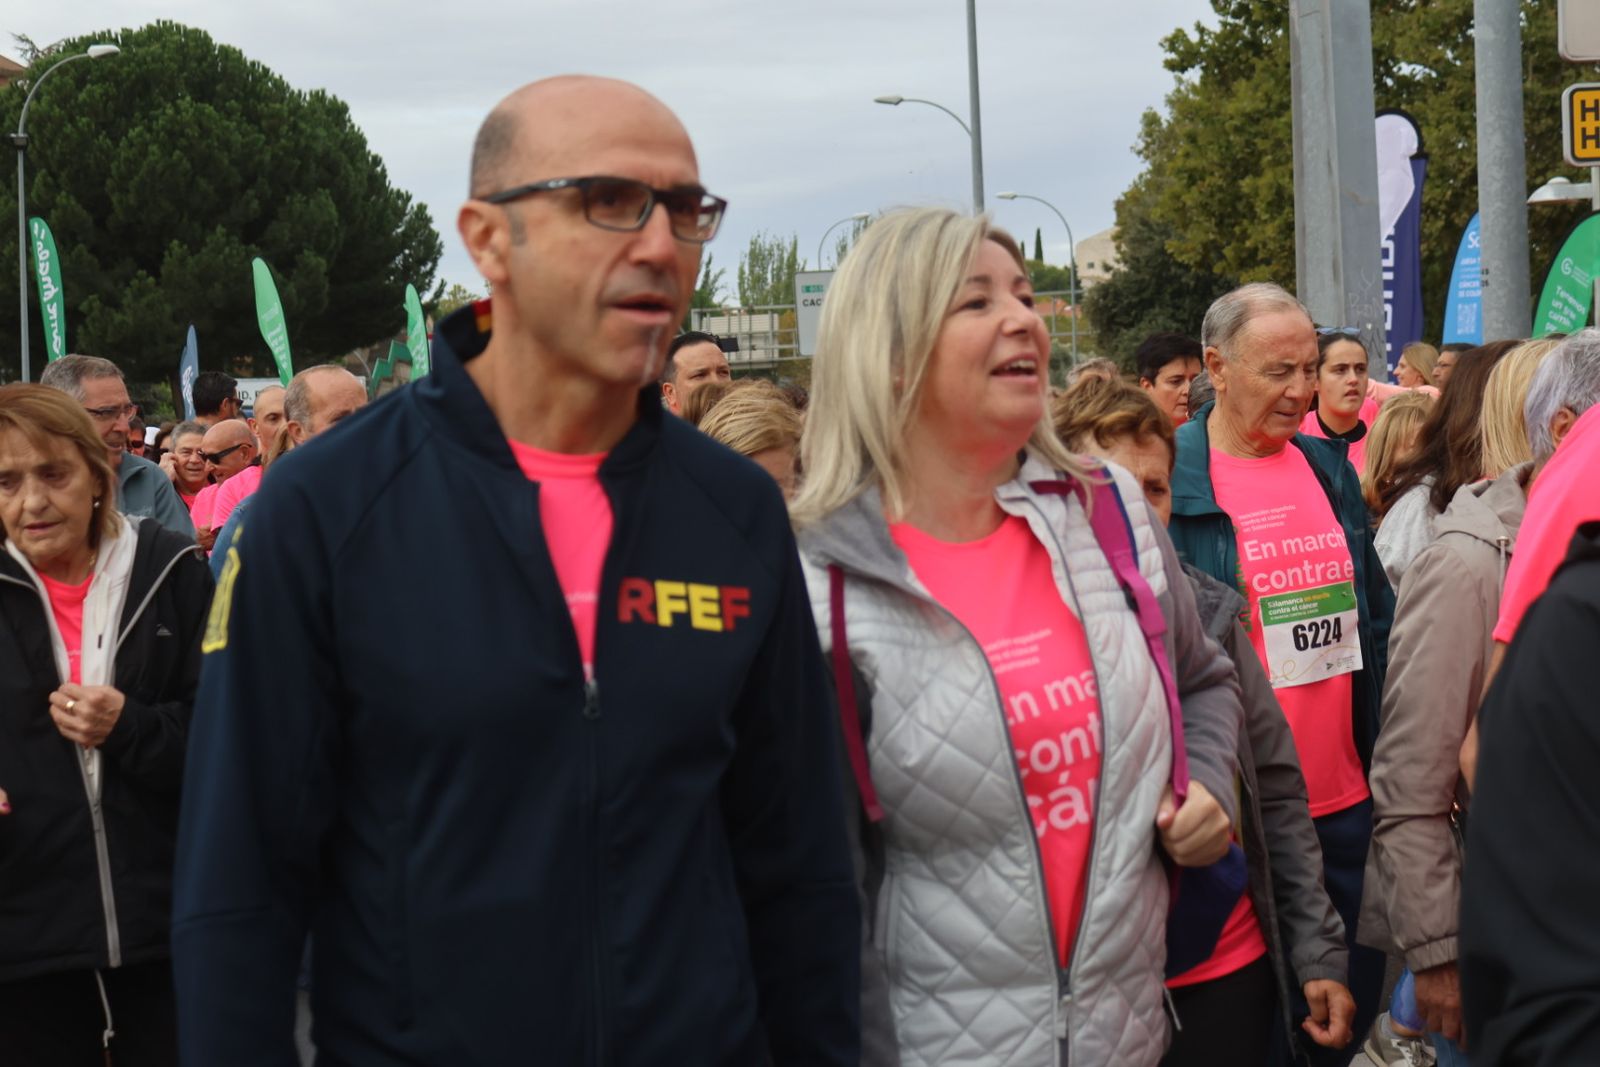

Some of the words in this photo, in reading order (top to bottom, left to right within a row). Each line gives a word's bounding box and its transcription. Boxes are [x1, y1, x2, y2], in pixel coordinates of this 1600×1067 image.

[1243, 540, 1277, 561] En
[1252, 559, 1342, 593] contra
[617, 577, 752, 632] RFEF
[1292, 617, 1343, 652] 6224
[1007, 691, 1040, 725] n
